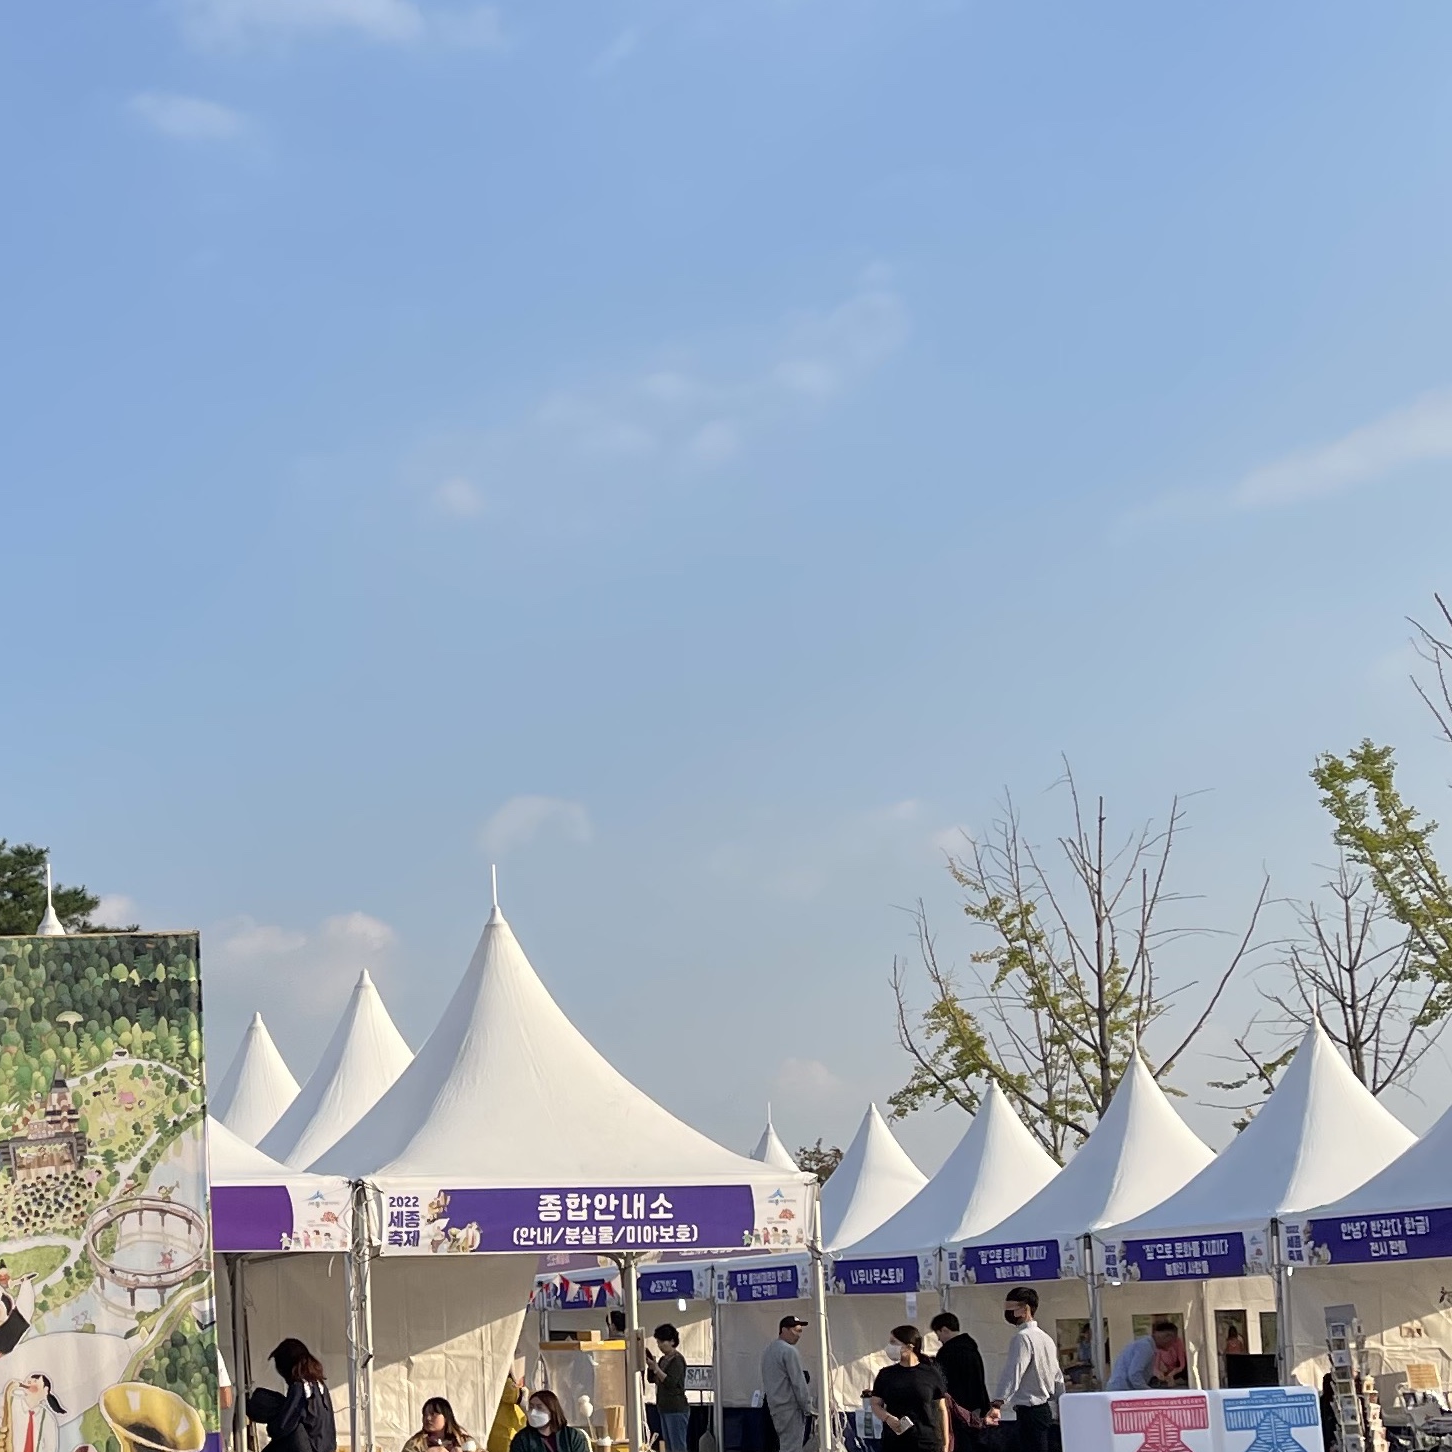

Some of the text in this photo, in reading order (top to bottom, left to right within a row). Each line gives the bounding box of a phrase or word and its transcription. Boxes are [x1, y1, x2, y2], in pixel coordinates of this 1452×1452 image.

[389, 1196, 420, 1208] 2022
[537, 1192, 674, 1222] 종합안내소
[388, 1210, 421, 1228] 세종
[388, 1230, 421, 1247] 축제
[512, 1224, 699, 1246] (안내/분실물/미아보호)
